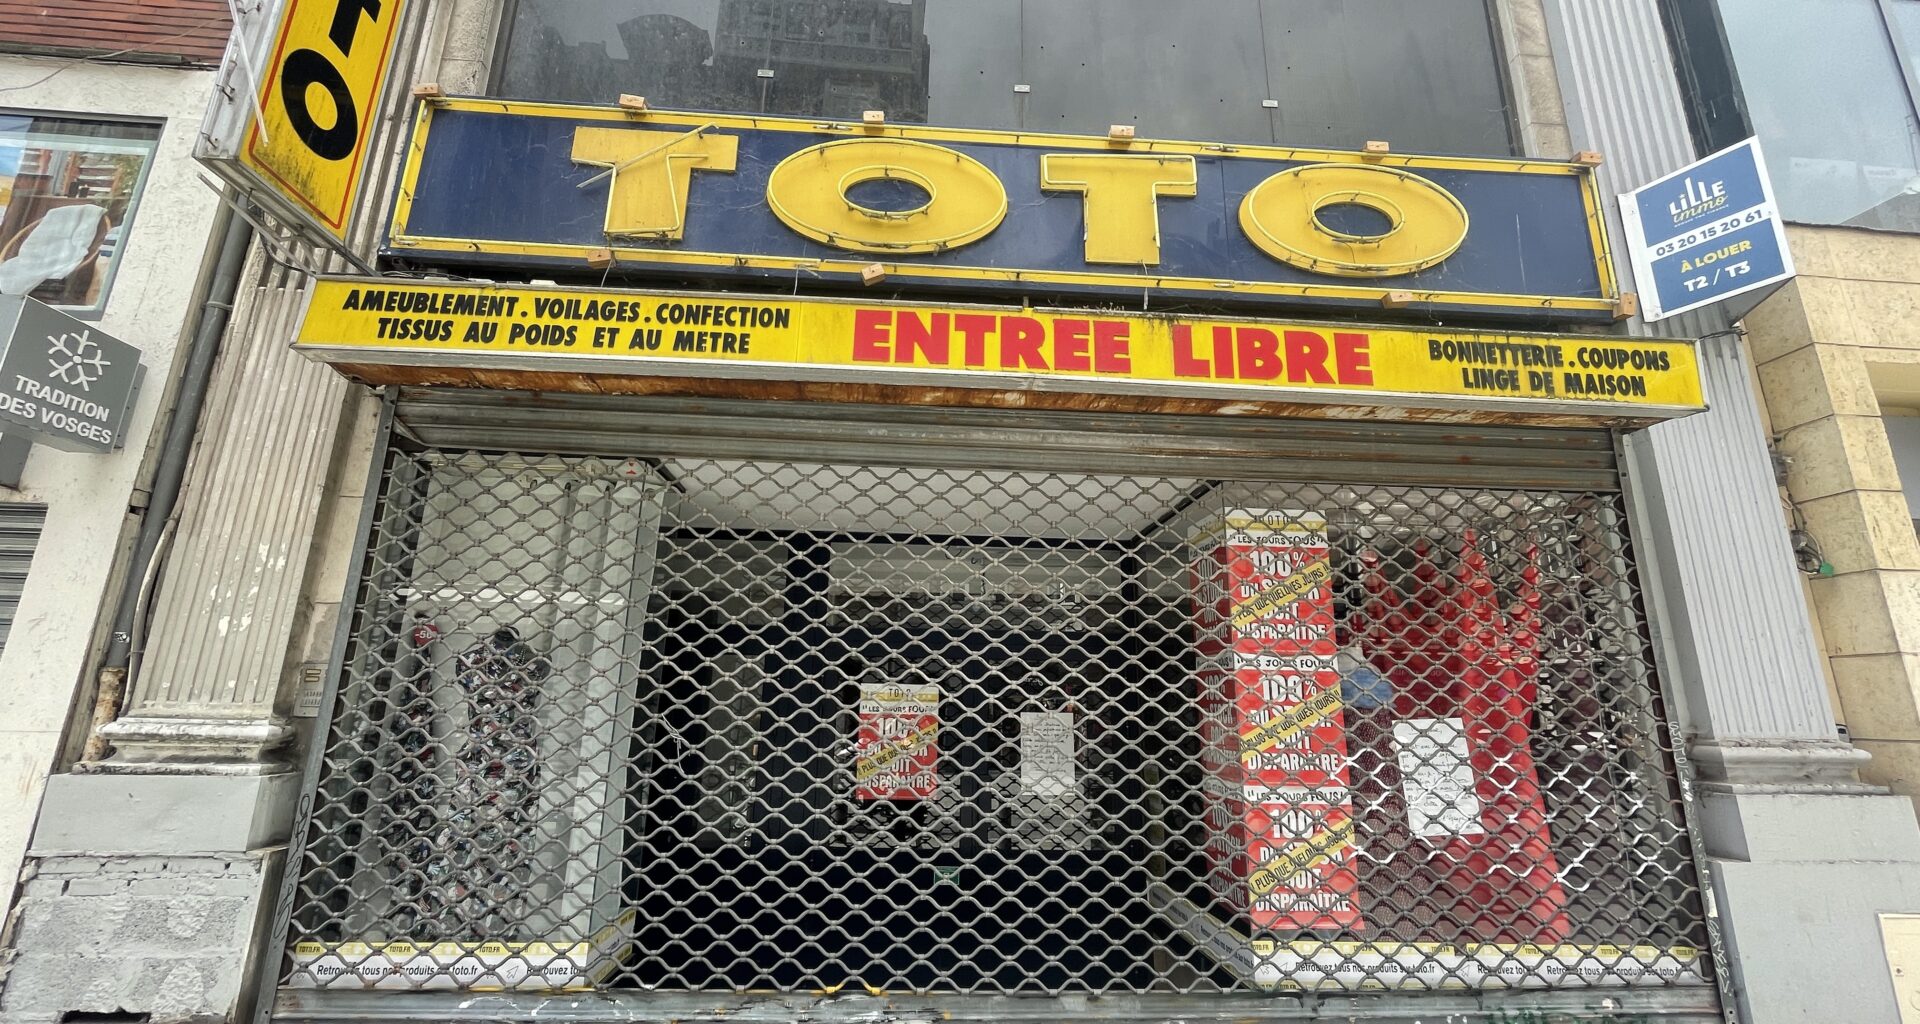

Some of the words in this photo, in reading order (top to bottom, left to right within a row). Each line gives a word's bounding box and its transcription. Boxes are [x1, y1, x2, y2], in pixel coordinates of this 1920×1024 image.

[571, 124, 1470, 277] TOTO
[1673, 195, 1729, 223] immo
[1656, 243, 1675, 256] 03
[1678, 234, 1697, 248] 20
[1700, 226, 1717, 240] 15
[1720, 218, 1740, 232] 20
[1745, 210, 1763, 224] 61
[1680, 259, 1693, 273] À
[1695, 240, 1752, 268] LOUER
[1683, 276, 1708, 292] T2
[1725, 260, 1750, 277] T3
[657, 303, 790, 329] CONFECTION
[377, 318, 454, 342] TISSUS
[463, 321, 498, 344] AU
[508, 323, 577, 347] POIDS
[593, 326, 619, 348] ET
[629, 328, 662, 350] AU
[673, 330, 751, 354] METRE
[852, 309, 1131, 373] ENTREE
[1172, 323, 1375, 386] LIBRE
[1577, 347, 1670, 371] COUPONS
[1462, 367, 1521, 392] LINGE
[1529, 370, 1554, 395] DE
[1564, 372, 1647, 397] MAISON
[16, 374, 110, 422] TRADITION
[0, 392, 37, 418] DES
[41, 407, 112, 444] VOSGES
[1255, 872, 1275, 891] PLUS
[299, 945, 321, 953] TOTO.FR
[389, 945, 411, 953] TOTO.FR
[362, 965, 381, 976] tous
